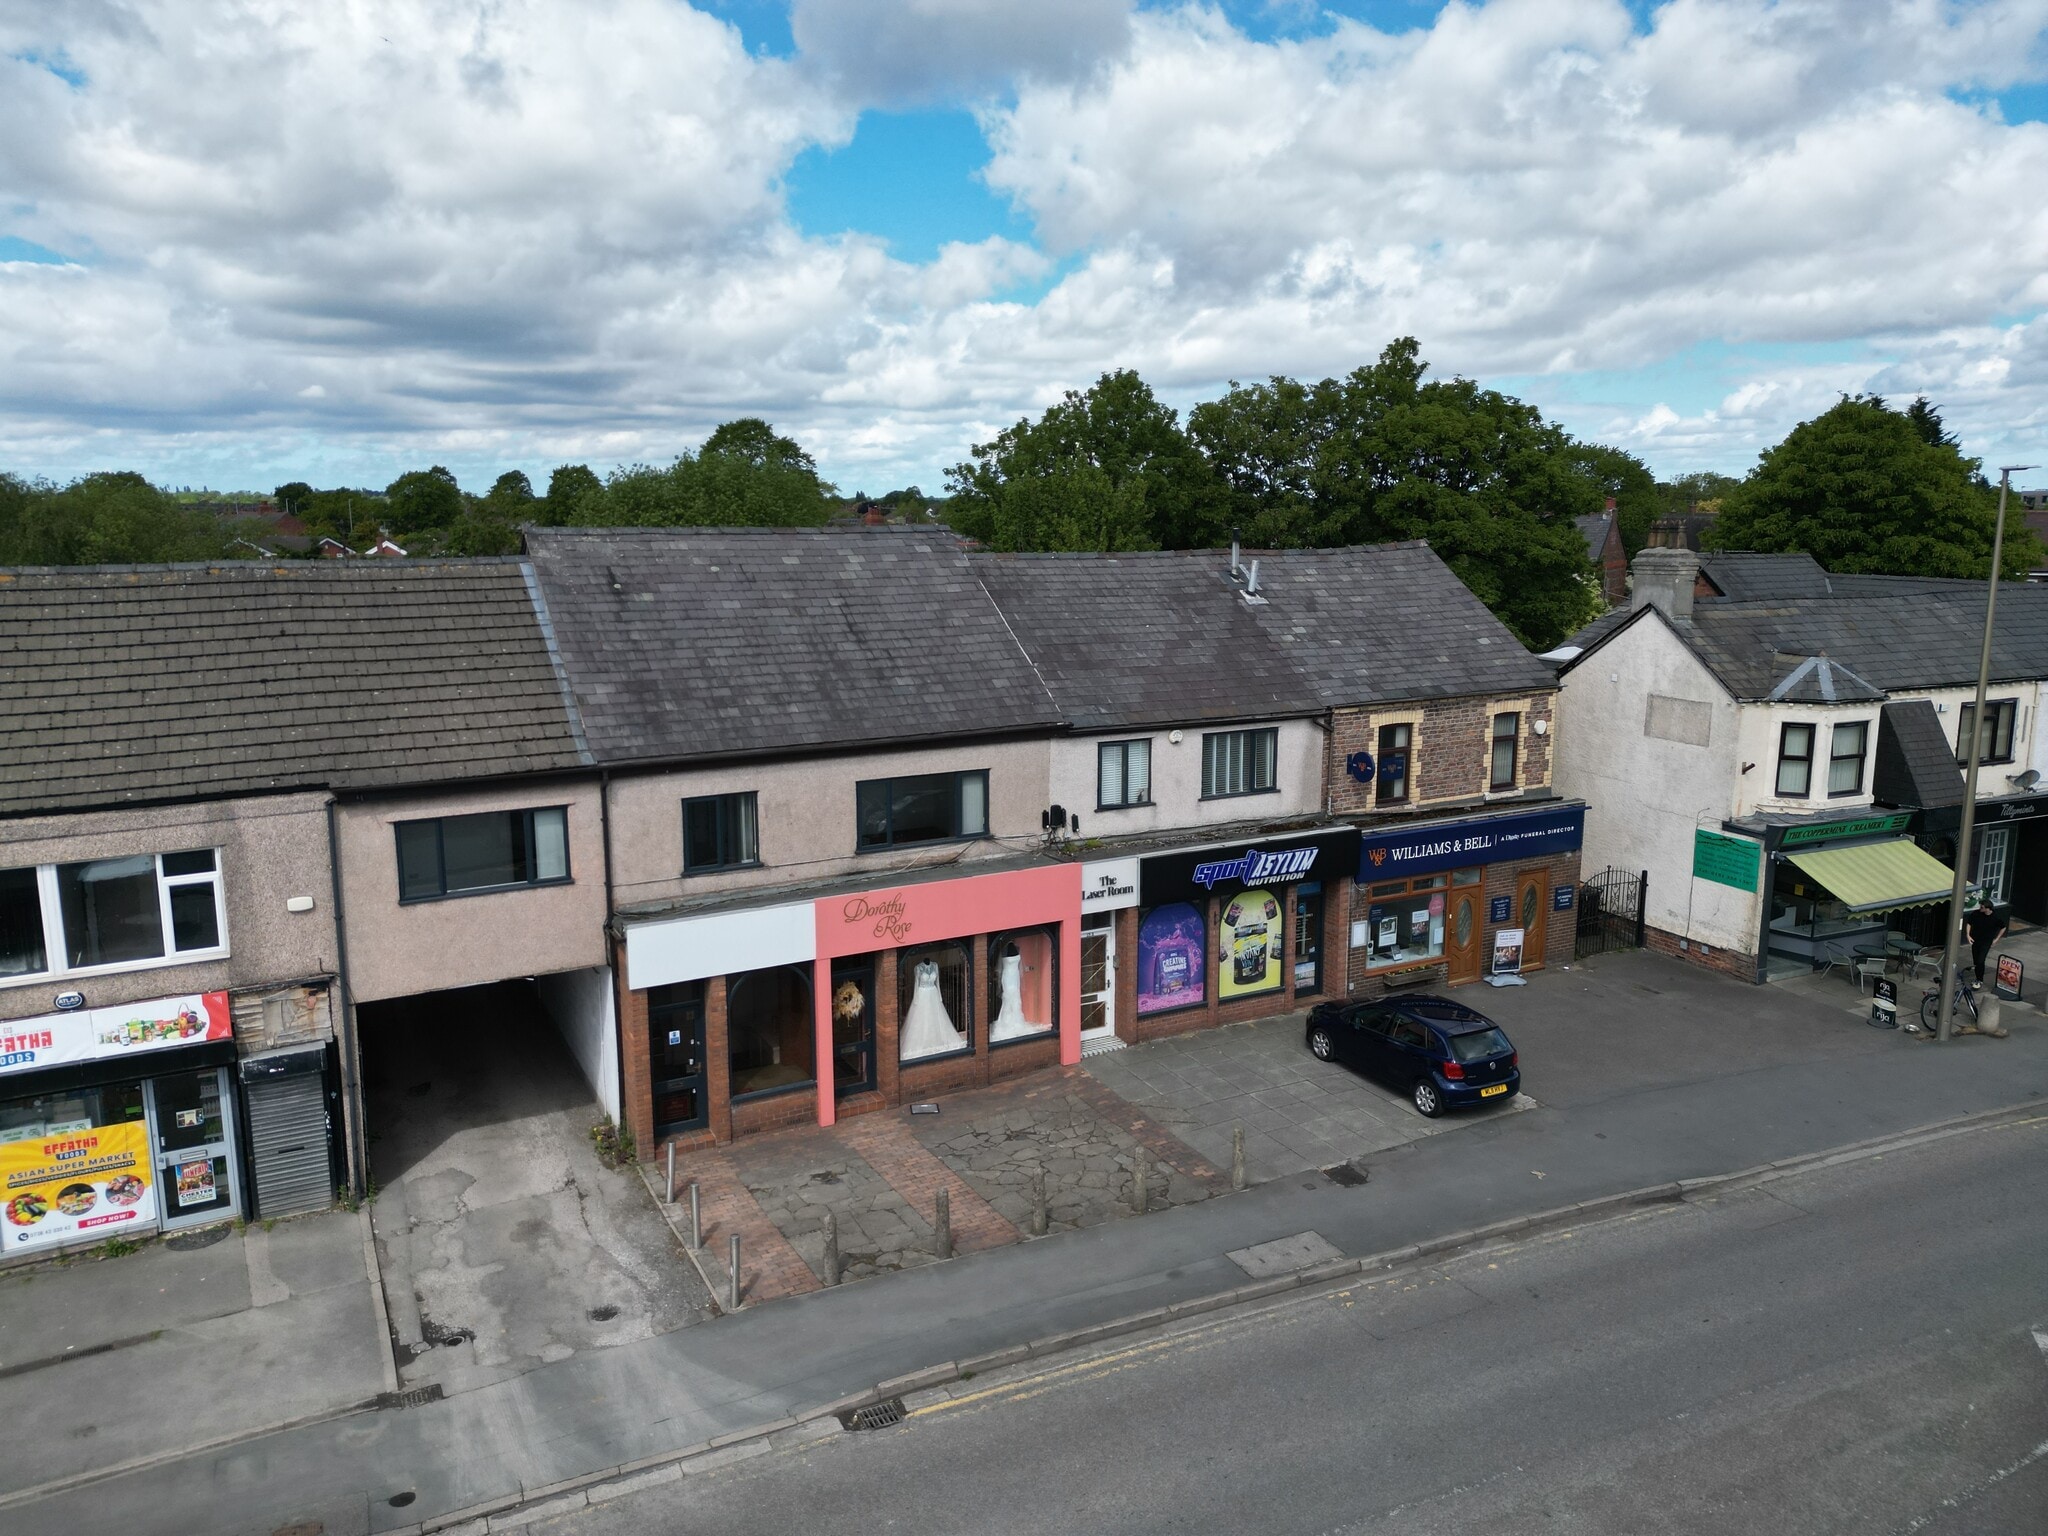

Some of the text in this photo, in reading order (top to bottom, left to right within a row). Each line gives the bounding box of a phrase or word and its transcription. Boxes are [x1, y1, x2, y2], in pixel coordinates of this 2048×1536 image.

[2001, 803, 2035, 818] Tillymints
[1521, 830, 1546, 839] FUNERAL
[1547, 826, 1575, 835] DIRECTOR
[1391, 835, 1492, 861] WILLIAMS & BELL
[1252, 847, 1319, 878] ASYLUM
[1099, 875, 1117, 886] The
[1248, 871, 1305, 887] NUTRITION
[1081, 885, 1134, 900] Laser Room
[843, 892, 906, 923] Dorothy
[873, 913, 913, 944] Rose
[2001, 959, 2020, 970] OPEN
[58, 996, 80, 1004] ATLAS
[0, 1031, 52, 1053] ATHA
[44, 1137, 98, 1155] EFFATHA
[59, 1150, 86, 1160] FOODS
[9, 1168, 45, 1180] ASIAN
[49, 1160, 85, 1173] SUPER
[88, 1152, 134, 1165] MARKET
[181, 1188, 213, 1198] CHESTER
[86, 1212, 130, 1226] SHOP NOW!
